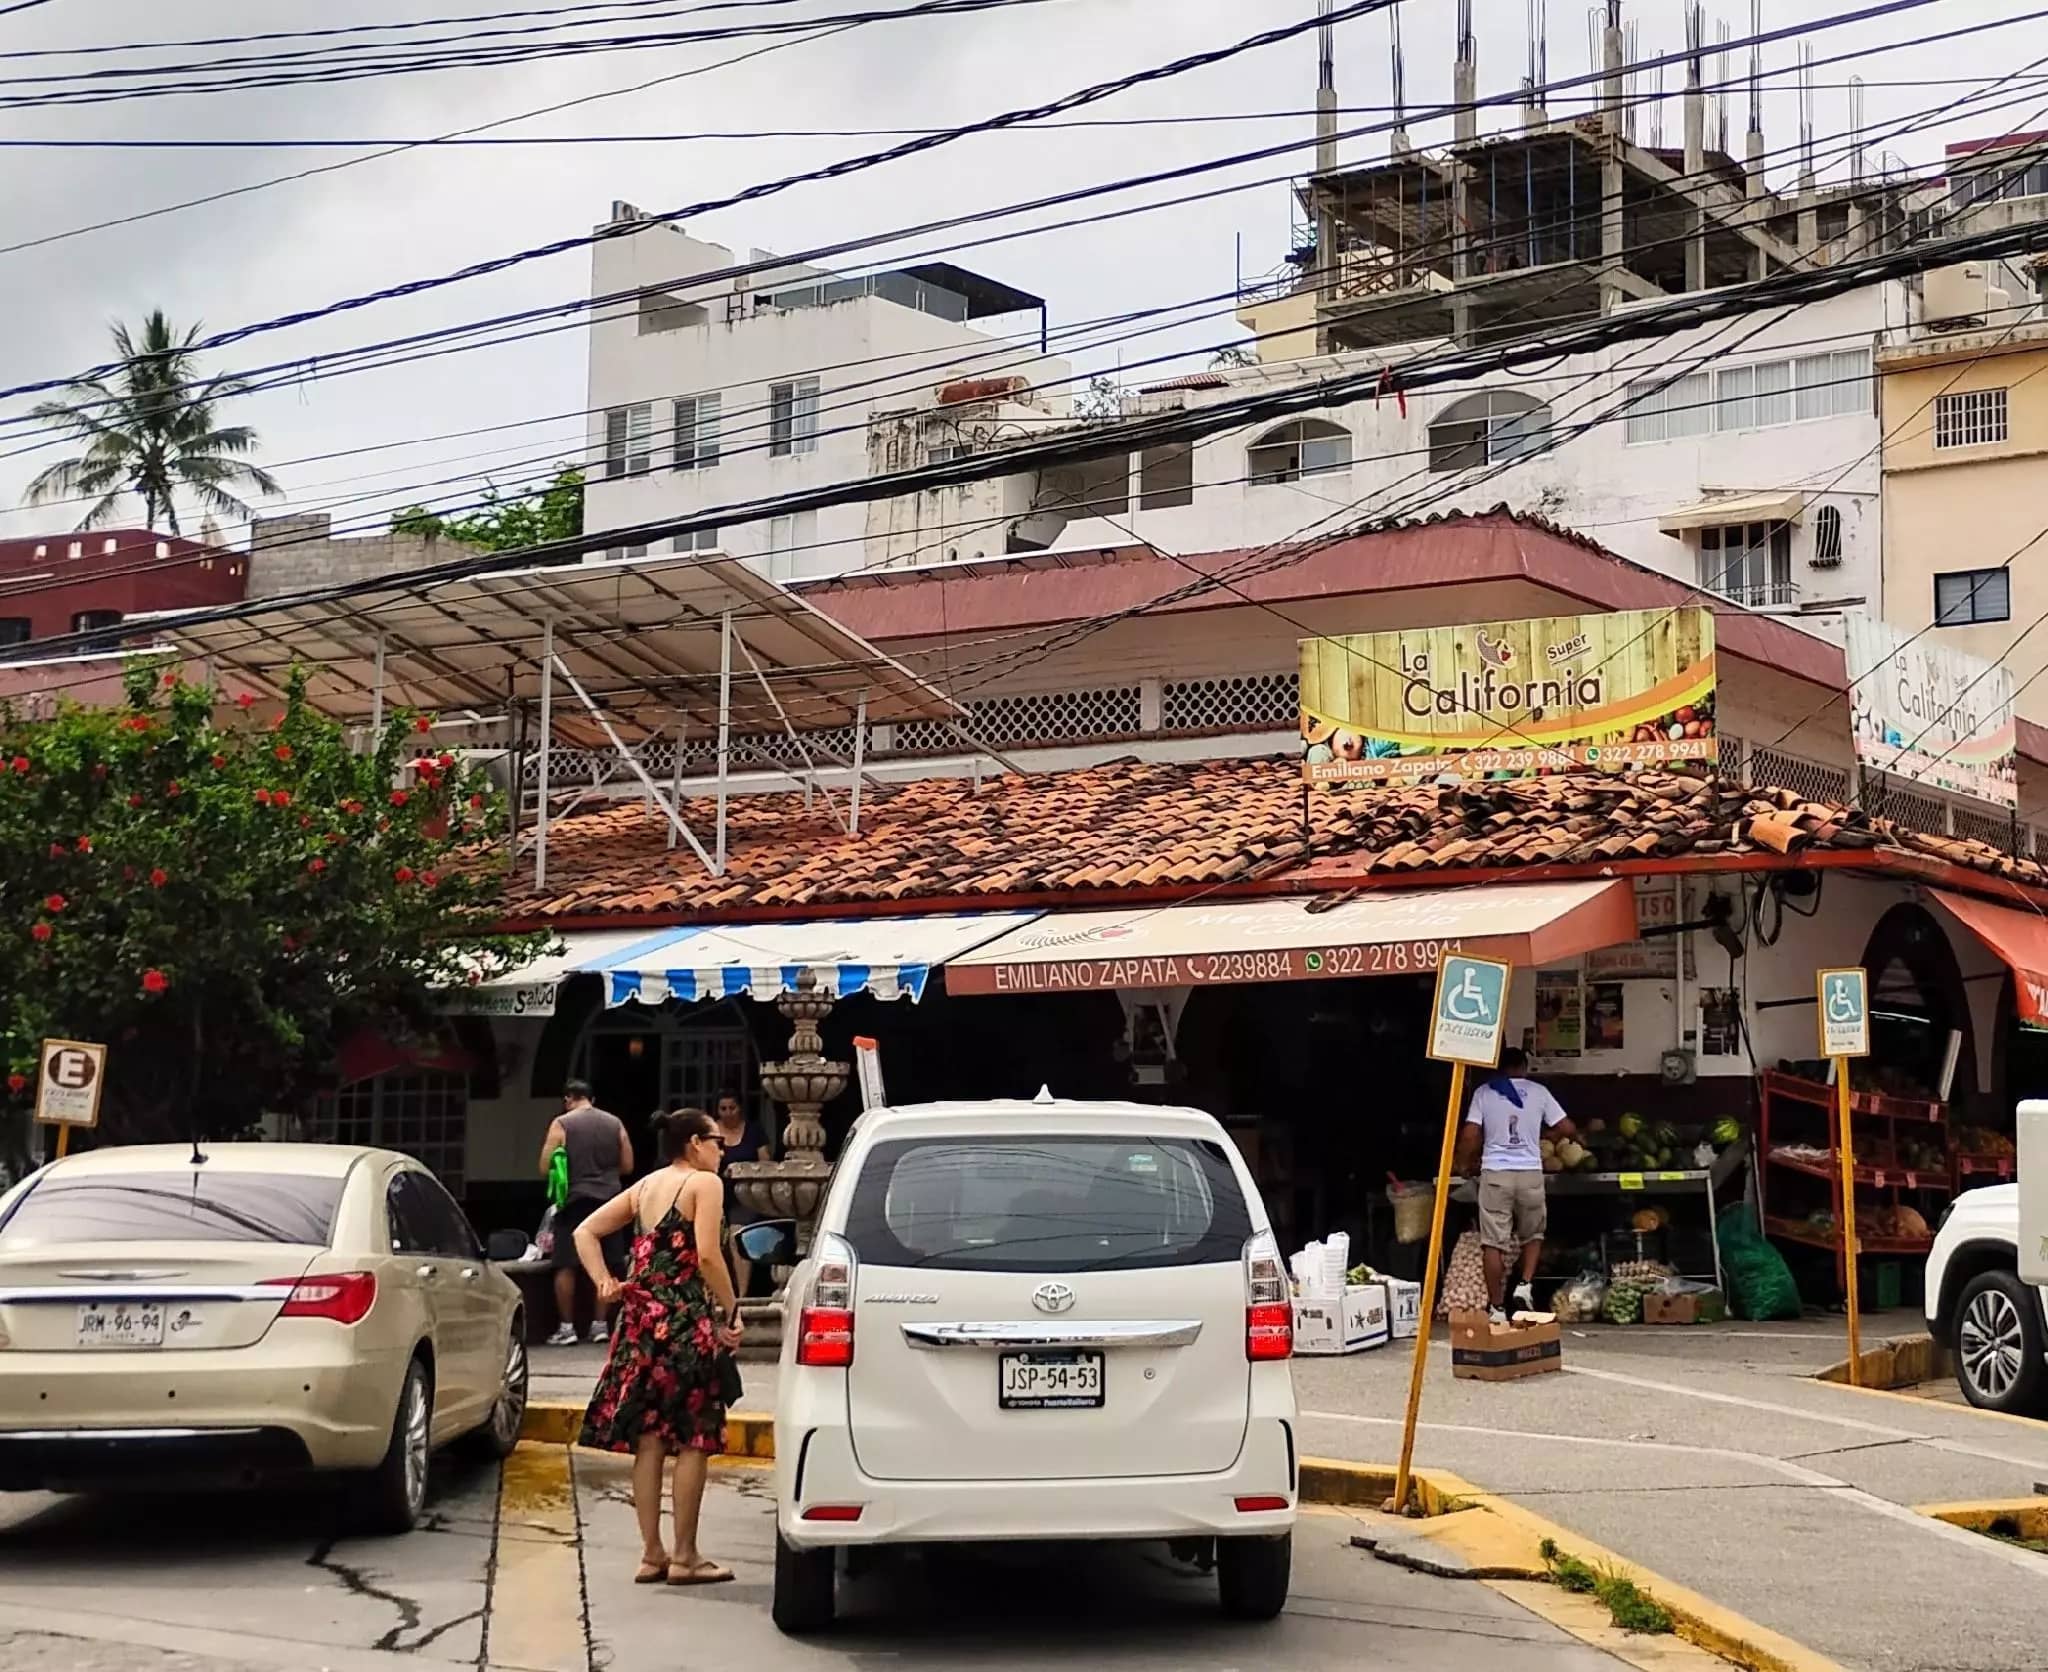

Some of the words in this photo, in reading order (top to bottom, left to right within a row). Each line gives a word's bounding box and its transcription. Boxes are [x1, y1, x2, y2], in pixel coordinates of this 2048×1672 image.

[1402, 644, 1428, 673] La
[1547, 632, 1587, 660] Super
[1403, 668, 1601, 717] California
[1897, 677, 1977, 736] California
[1311, 762, 1385, 779] Emiliano
[1390, 759, 1453, 777] Zapata
[1475, 753, 1502, 770] 322
[1506, 751, 1534, 768] 239
[1538, 748, 1575, 766] 9884
[1602, 746, 1632, 762] 322
[1637, 744, 1665, 760] 278
[1669, 742, 1707, 758] 9941
[995, 961, 1093, 990] EMILIANO
[1099, 957, 1180, 985] ZAPATA
[1207, 951, 1292, 981] 2239884
[1326, 946, 1364, 973] 322
[1369, 943, 1408, 971] 278
[514, 984, 554, 1014] Salud
[58, 1050, 86, 1086] E
[1006, 1366, 1098, 1391] JSP-54-53
